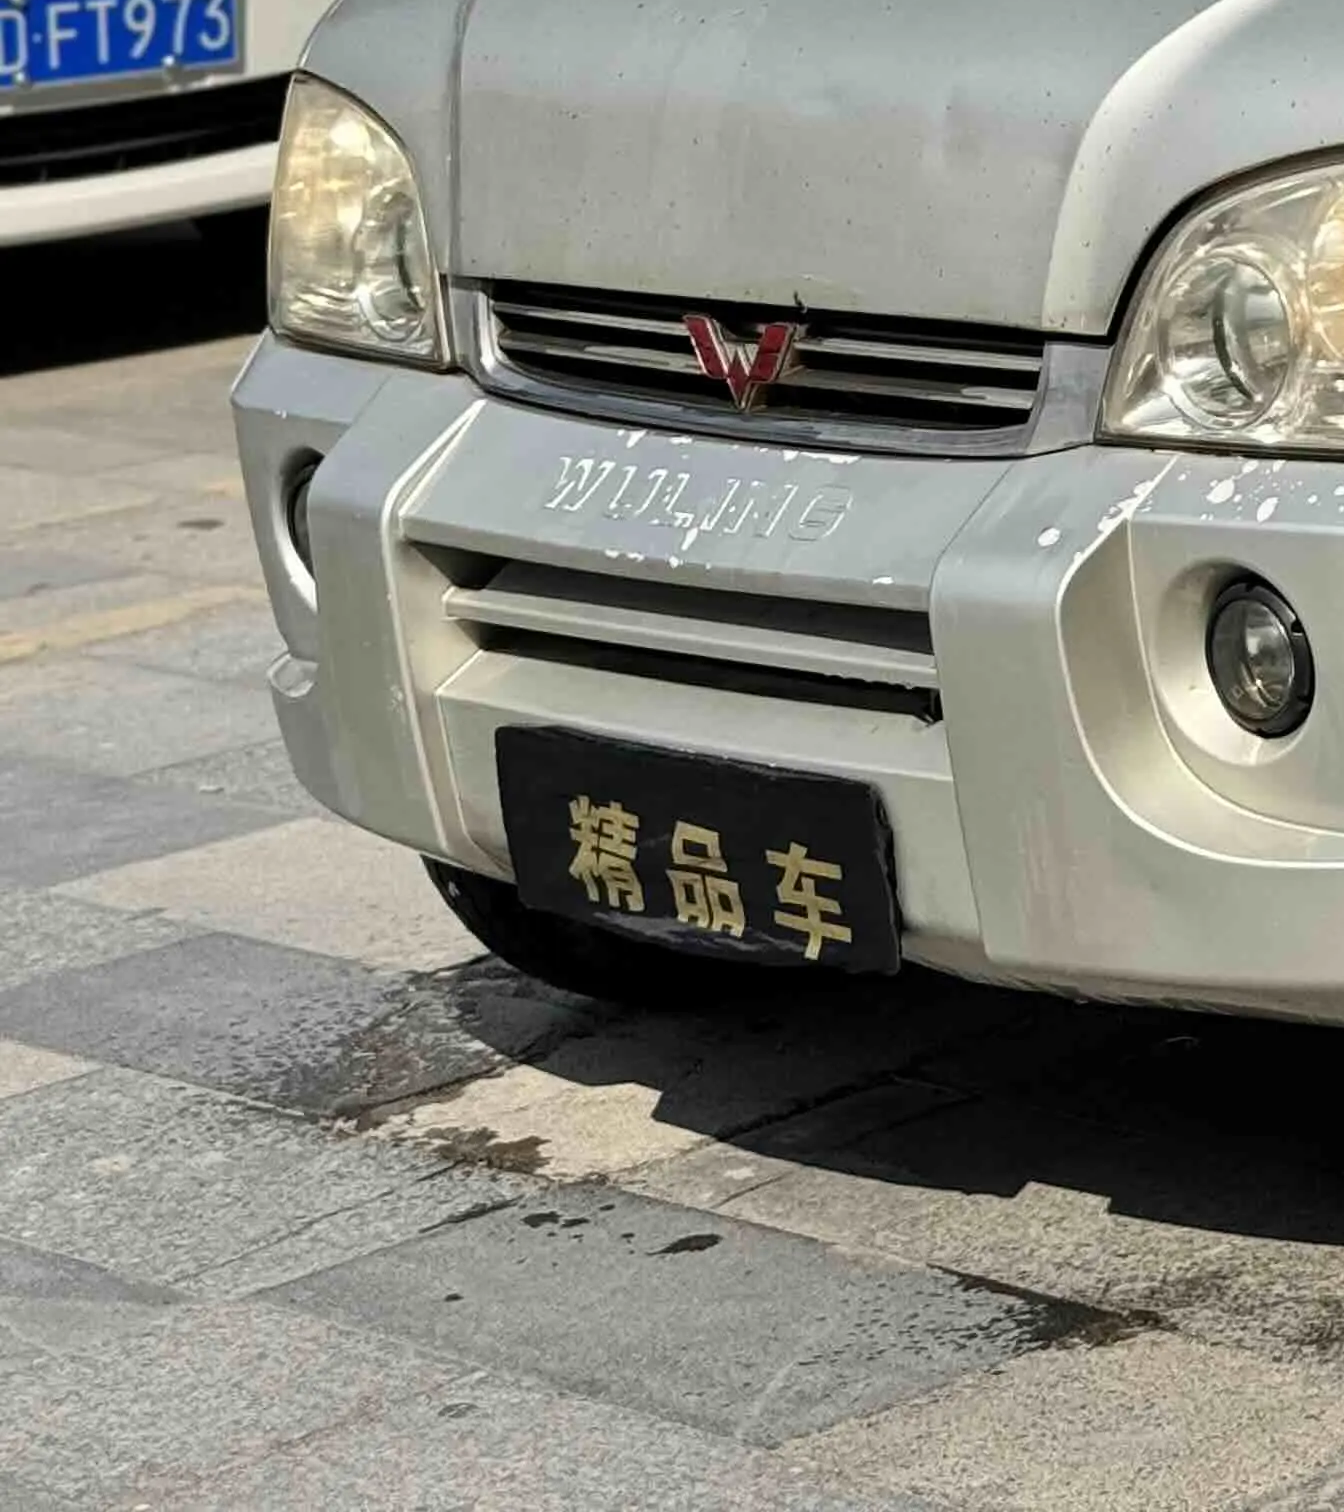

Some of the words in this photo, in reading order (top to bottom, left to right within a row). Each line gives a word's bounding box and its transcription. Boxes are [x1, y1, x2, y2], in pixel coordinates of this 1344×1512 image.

[544, 455, 854, 542] WULING
[567, 793, 853, 962] 精品车
